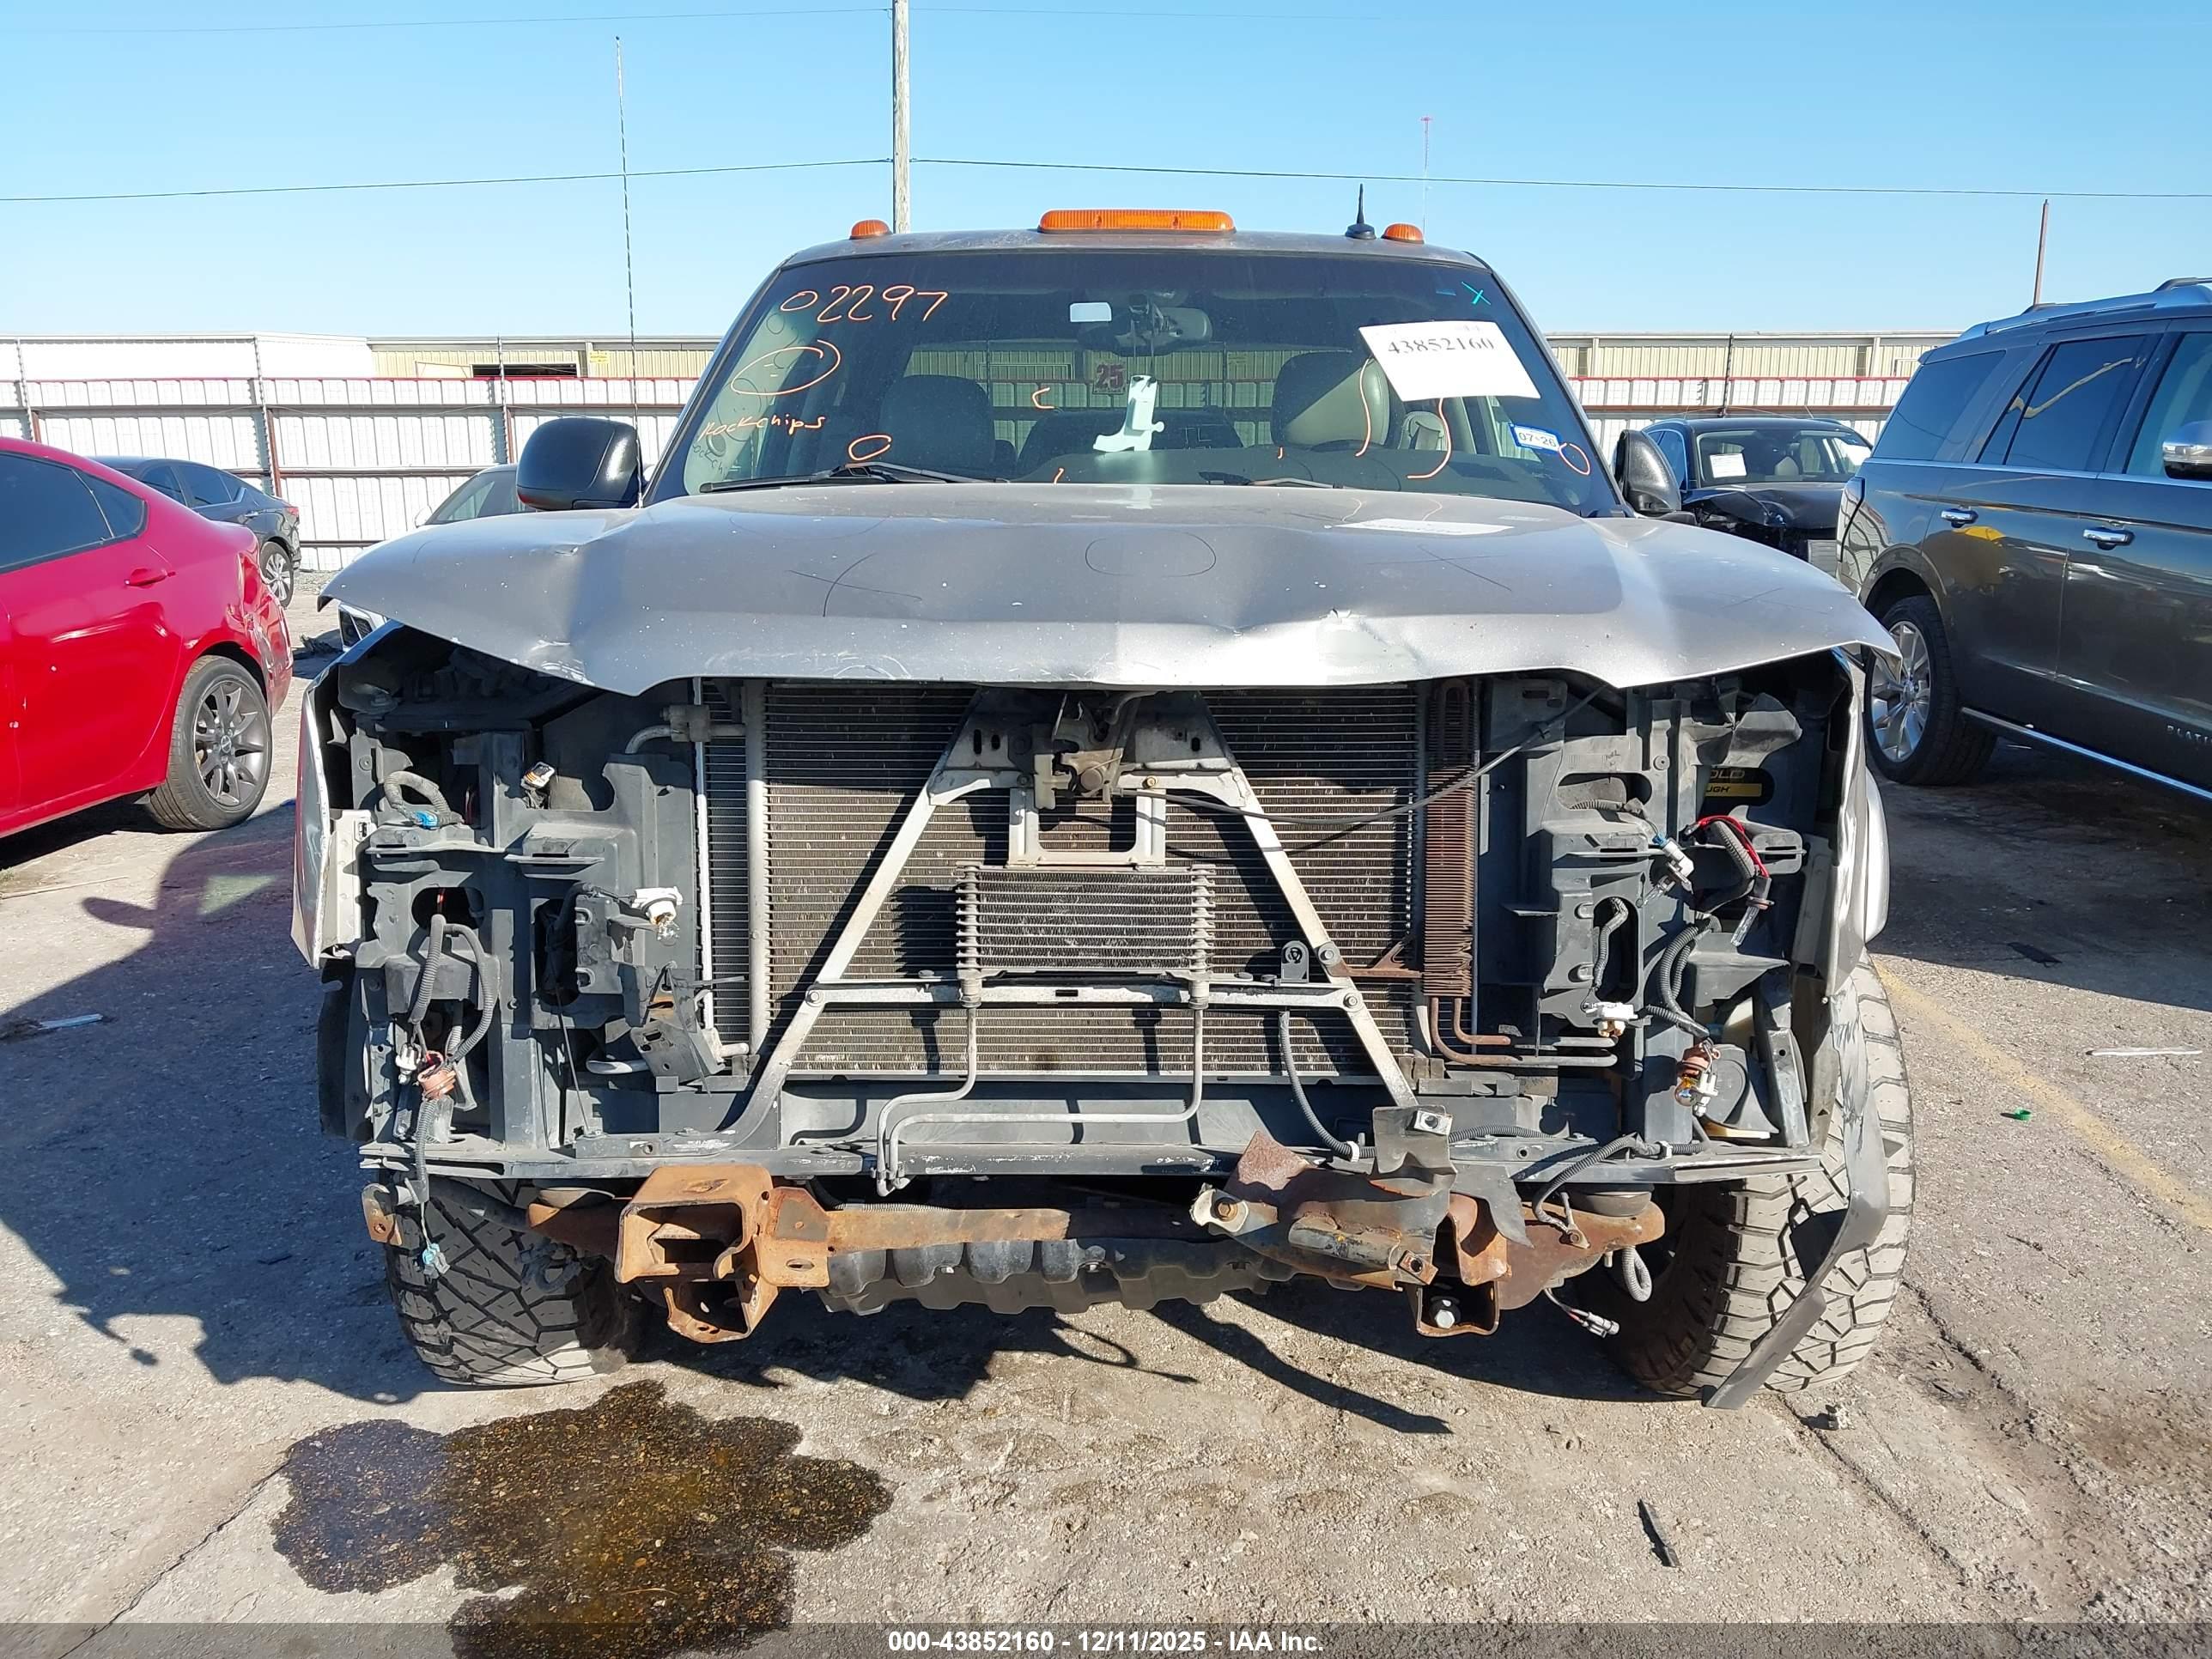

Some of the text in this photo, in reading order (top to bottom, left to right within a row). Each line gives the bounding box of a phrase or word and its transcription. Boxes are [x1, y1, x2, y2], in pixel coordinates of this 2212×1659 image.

[780, 285, 948, 323] 02297
[1388, 337, 1494, 355] 43852160
[1096, 363, 1124, 388] 25
